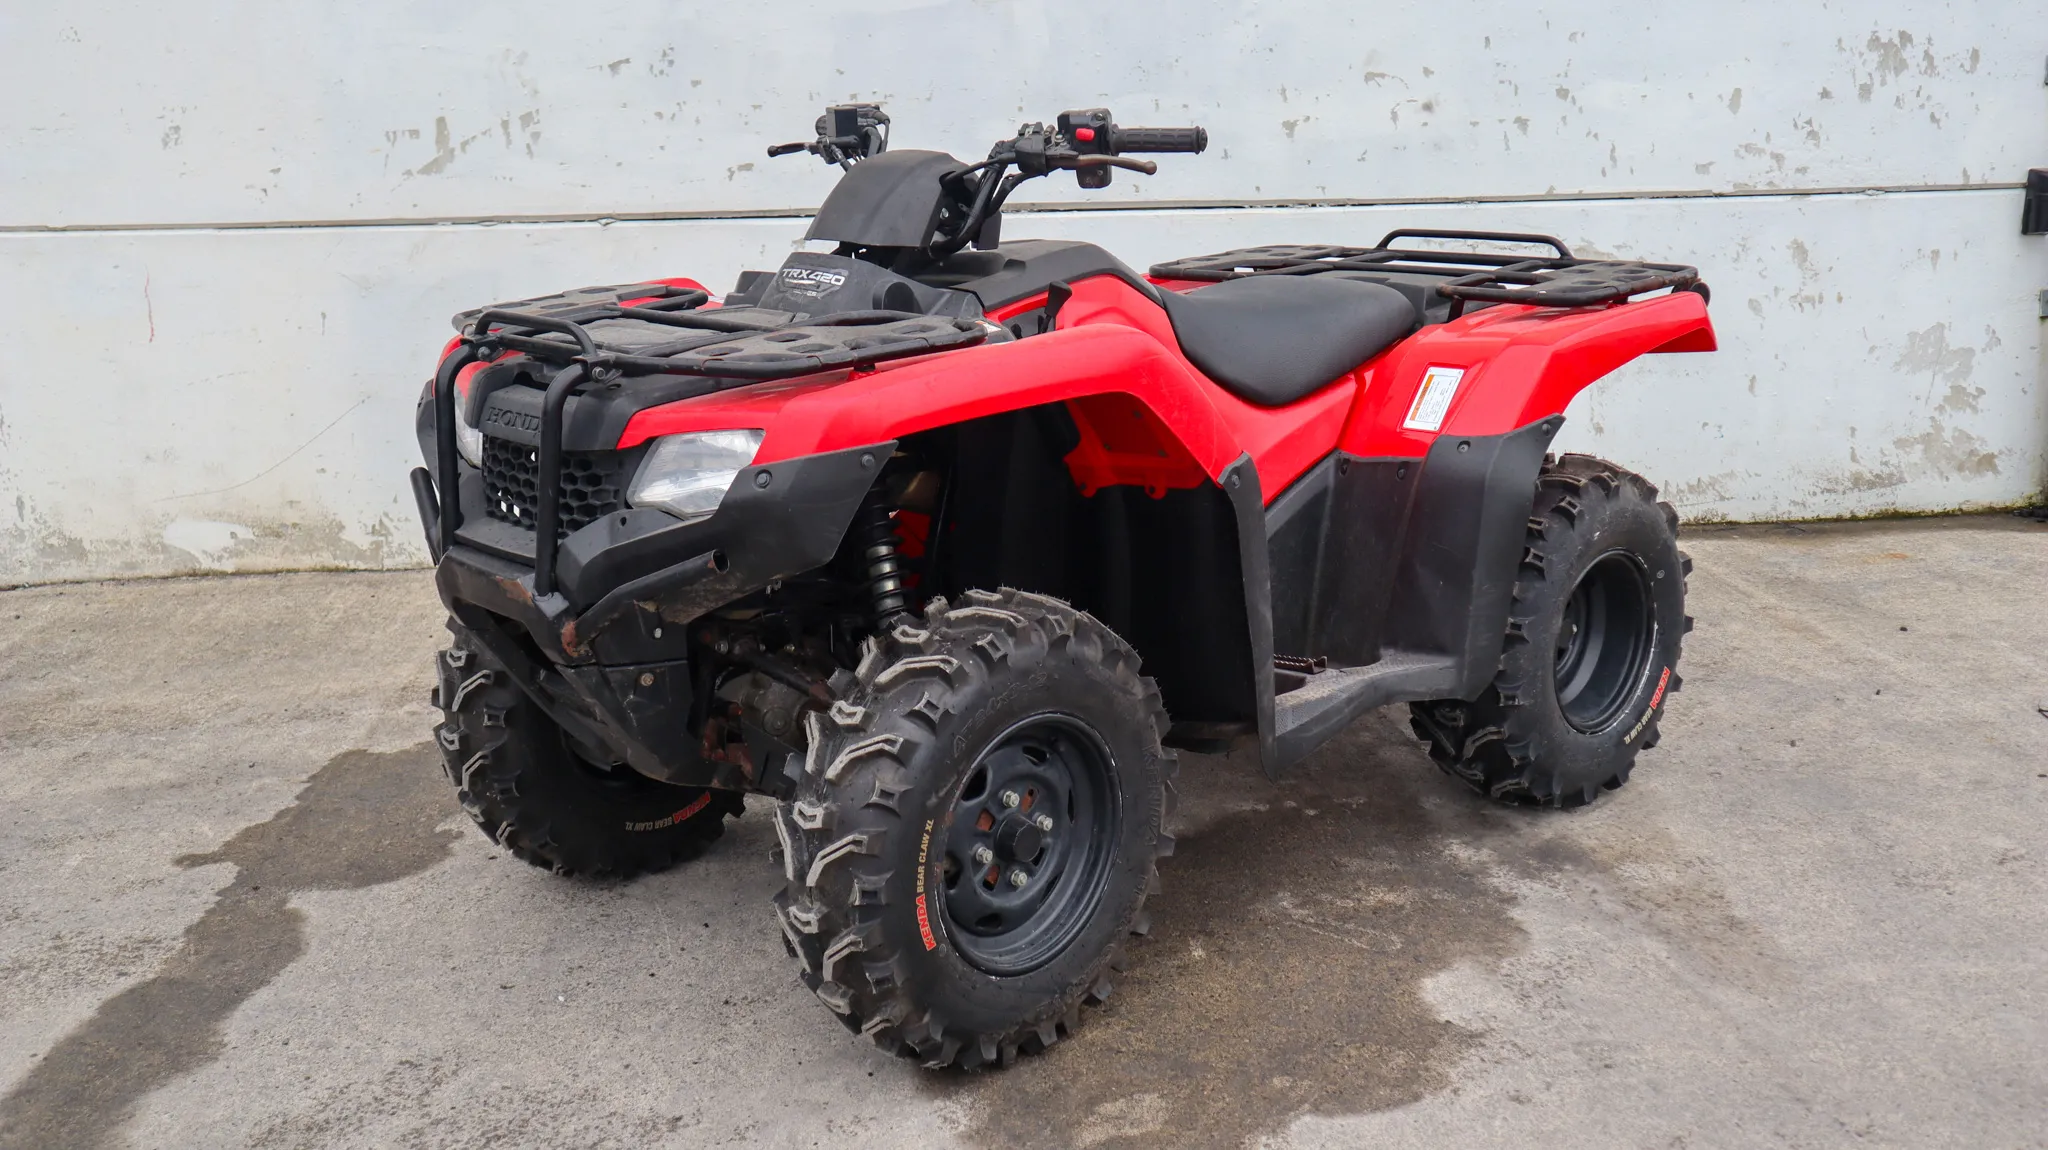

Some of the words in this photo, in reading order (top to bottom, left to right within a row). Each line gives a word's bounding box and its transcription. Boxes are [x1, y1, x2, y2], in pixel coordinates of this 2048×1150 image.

[782, 268, 846, 286] TRX420
[486, 406, 541, 433] HOND
[1649, 666, 1671, 710] KENDA
[925, 819, 934, 833] XL
[919, 833, 930, 863] CLAW
[917, 865, 925, 893] BEAR
[916, 893, 937, 951] KENDA
